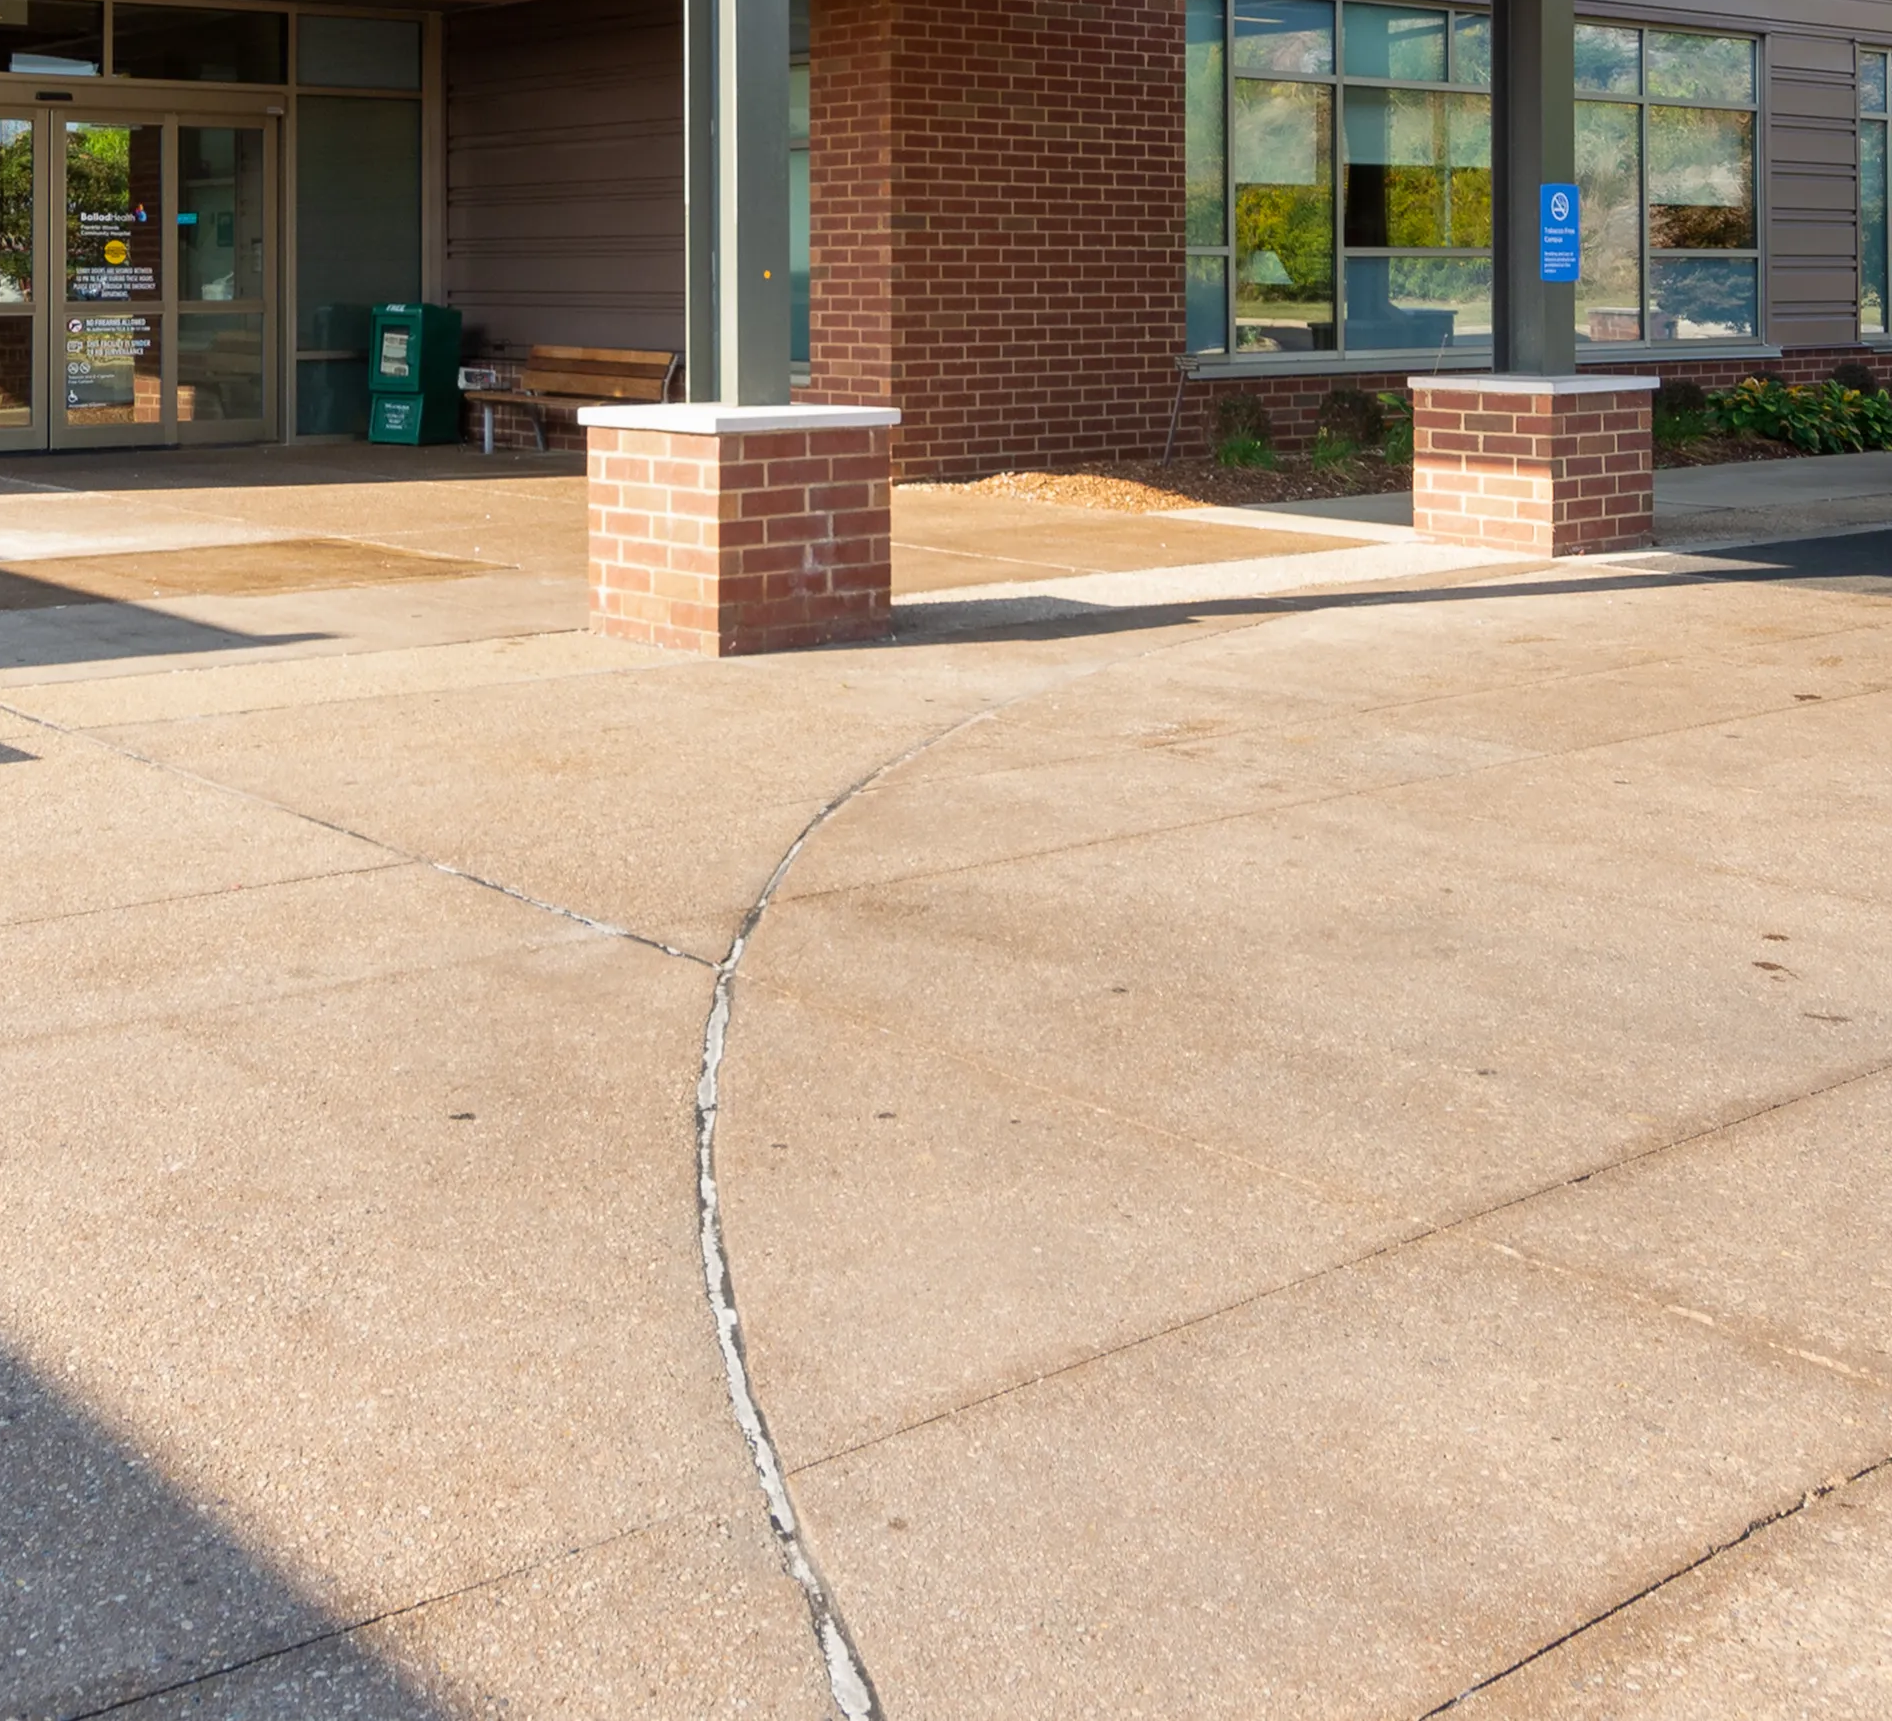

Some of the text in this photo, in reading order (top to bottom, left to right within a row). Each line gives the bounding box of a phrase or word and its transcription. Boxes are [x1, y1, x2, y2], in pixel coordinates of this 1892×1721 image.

[386, 304, 406, 312] FREE
[121, 318, 146, 326] ALLOWED
[131, 339, 151, 347] UNDER
[104, 348, 144, 356] SURVEILLANCE
